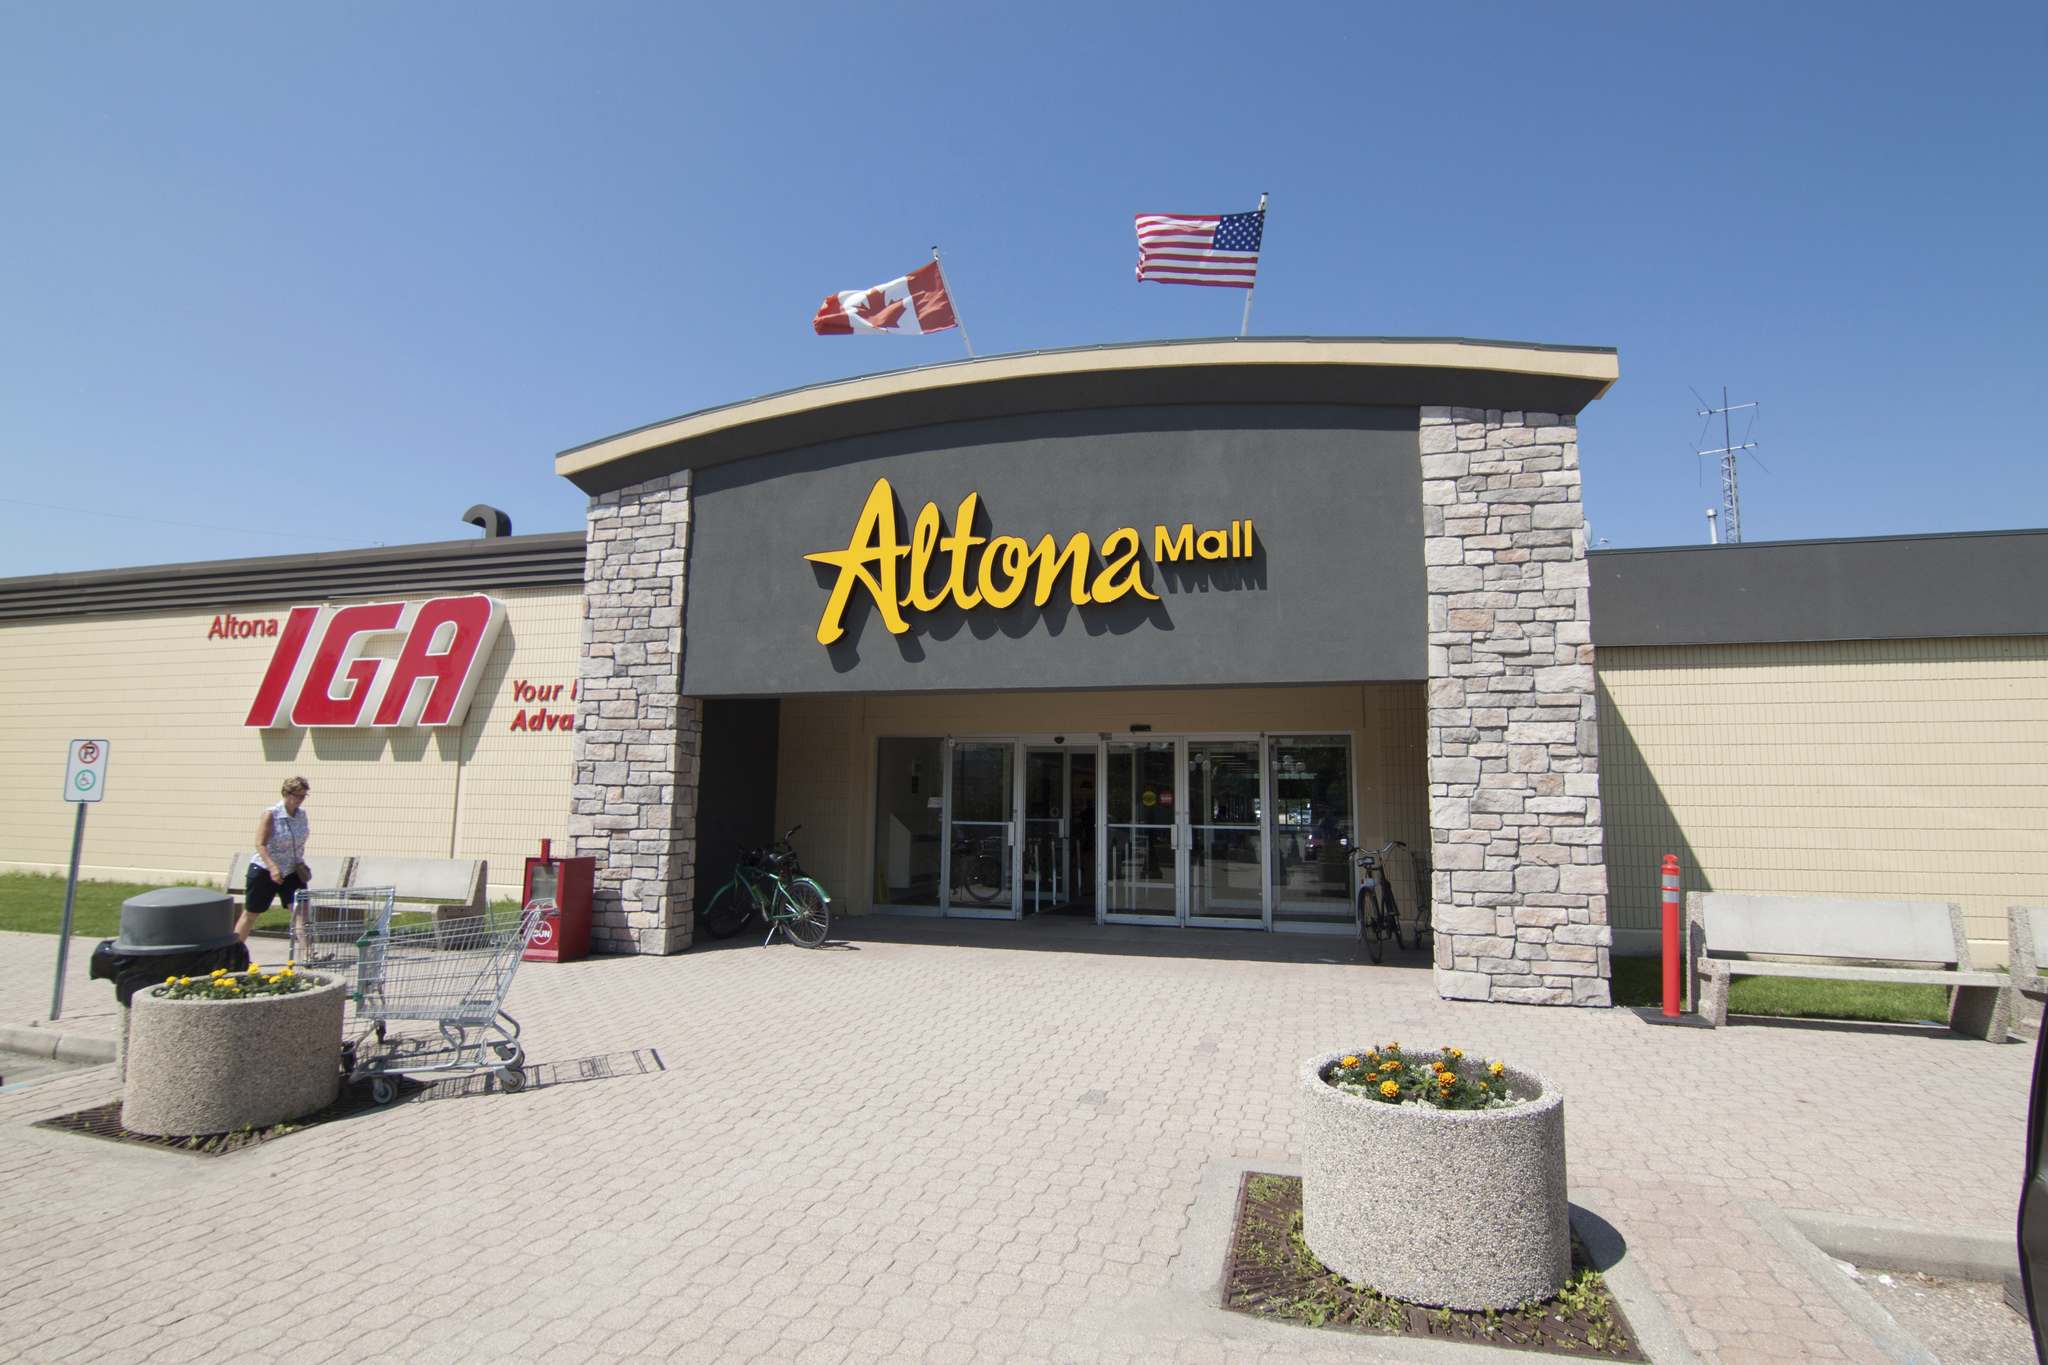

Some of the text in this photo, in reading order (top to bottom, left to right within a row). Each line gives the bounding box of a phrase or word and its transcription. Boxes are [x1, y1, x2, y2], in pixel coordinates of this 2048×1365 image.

[802, 477, 1254, 646] Altona Mall
[208, 614, 278, 640] Altona
[244, 593, 493, 728] IGA
[513, 680, 564, 703] Your
